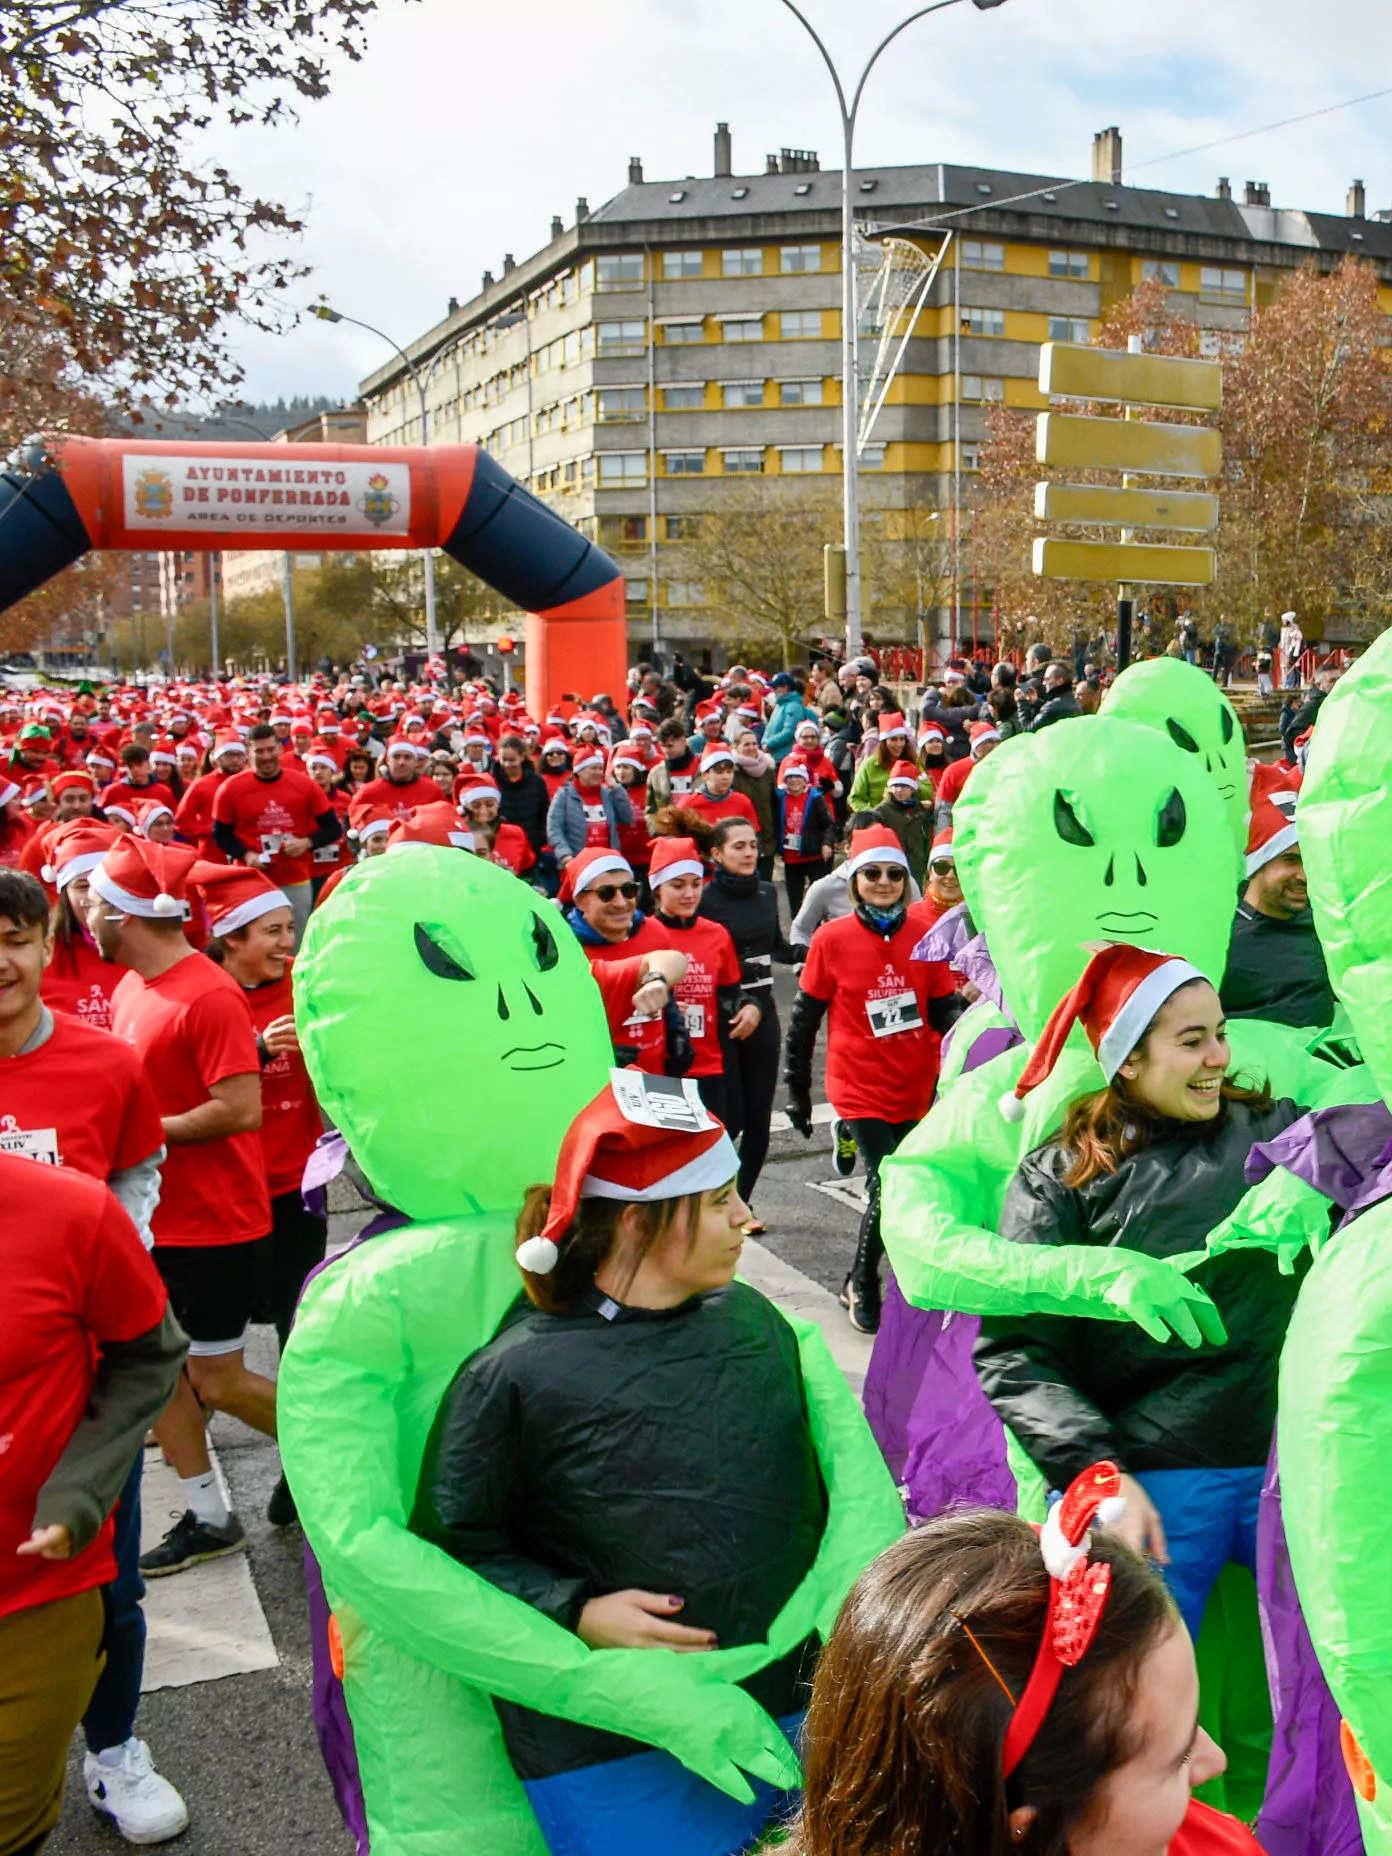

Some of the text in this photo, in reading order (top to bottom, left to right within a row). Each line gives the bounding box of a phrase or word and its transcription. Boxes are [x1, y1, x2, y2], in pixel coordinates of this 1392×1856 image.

[186, 466, 346, 485] AYUNTAMIENTO
[184, 487, 351, 506] DE PONFERRADA
[187, 512, 347, 524] AREA DE DEPORTES
[687, 964, 705, 974] AN
[877, 976, 905, 988] SAN
[882, 1008, 904, 1027] 22
[646, 1091, 698, 1123] 160
